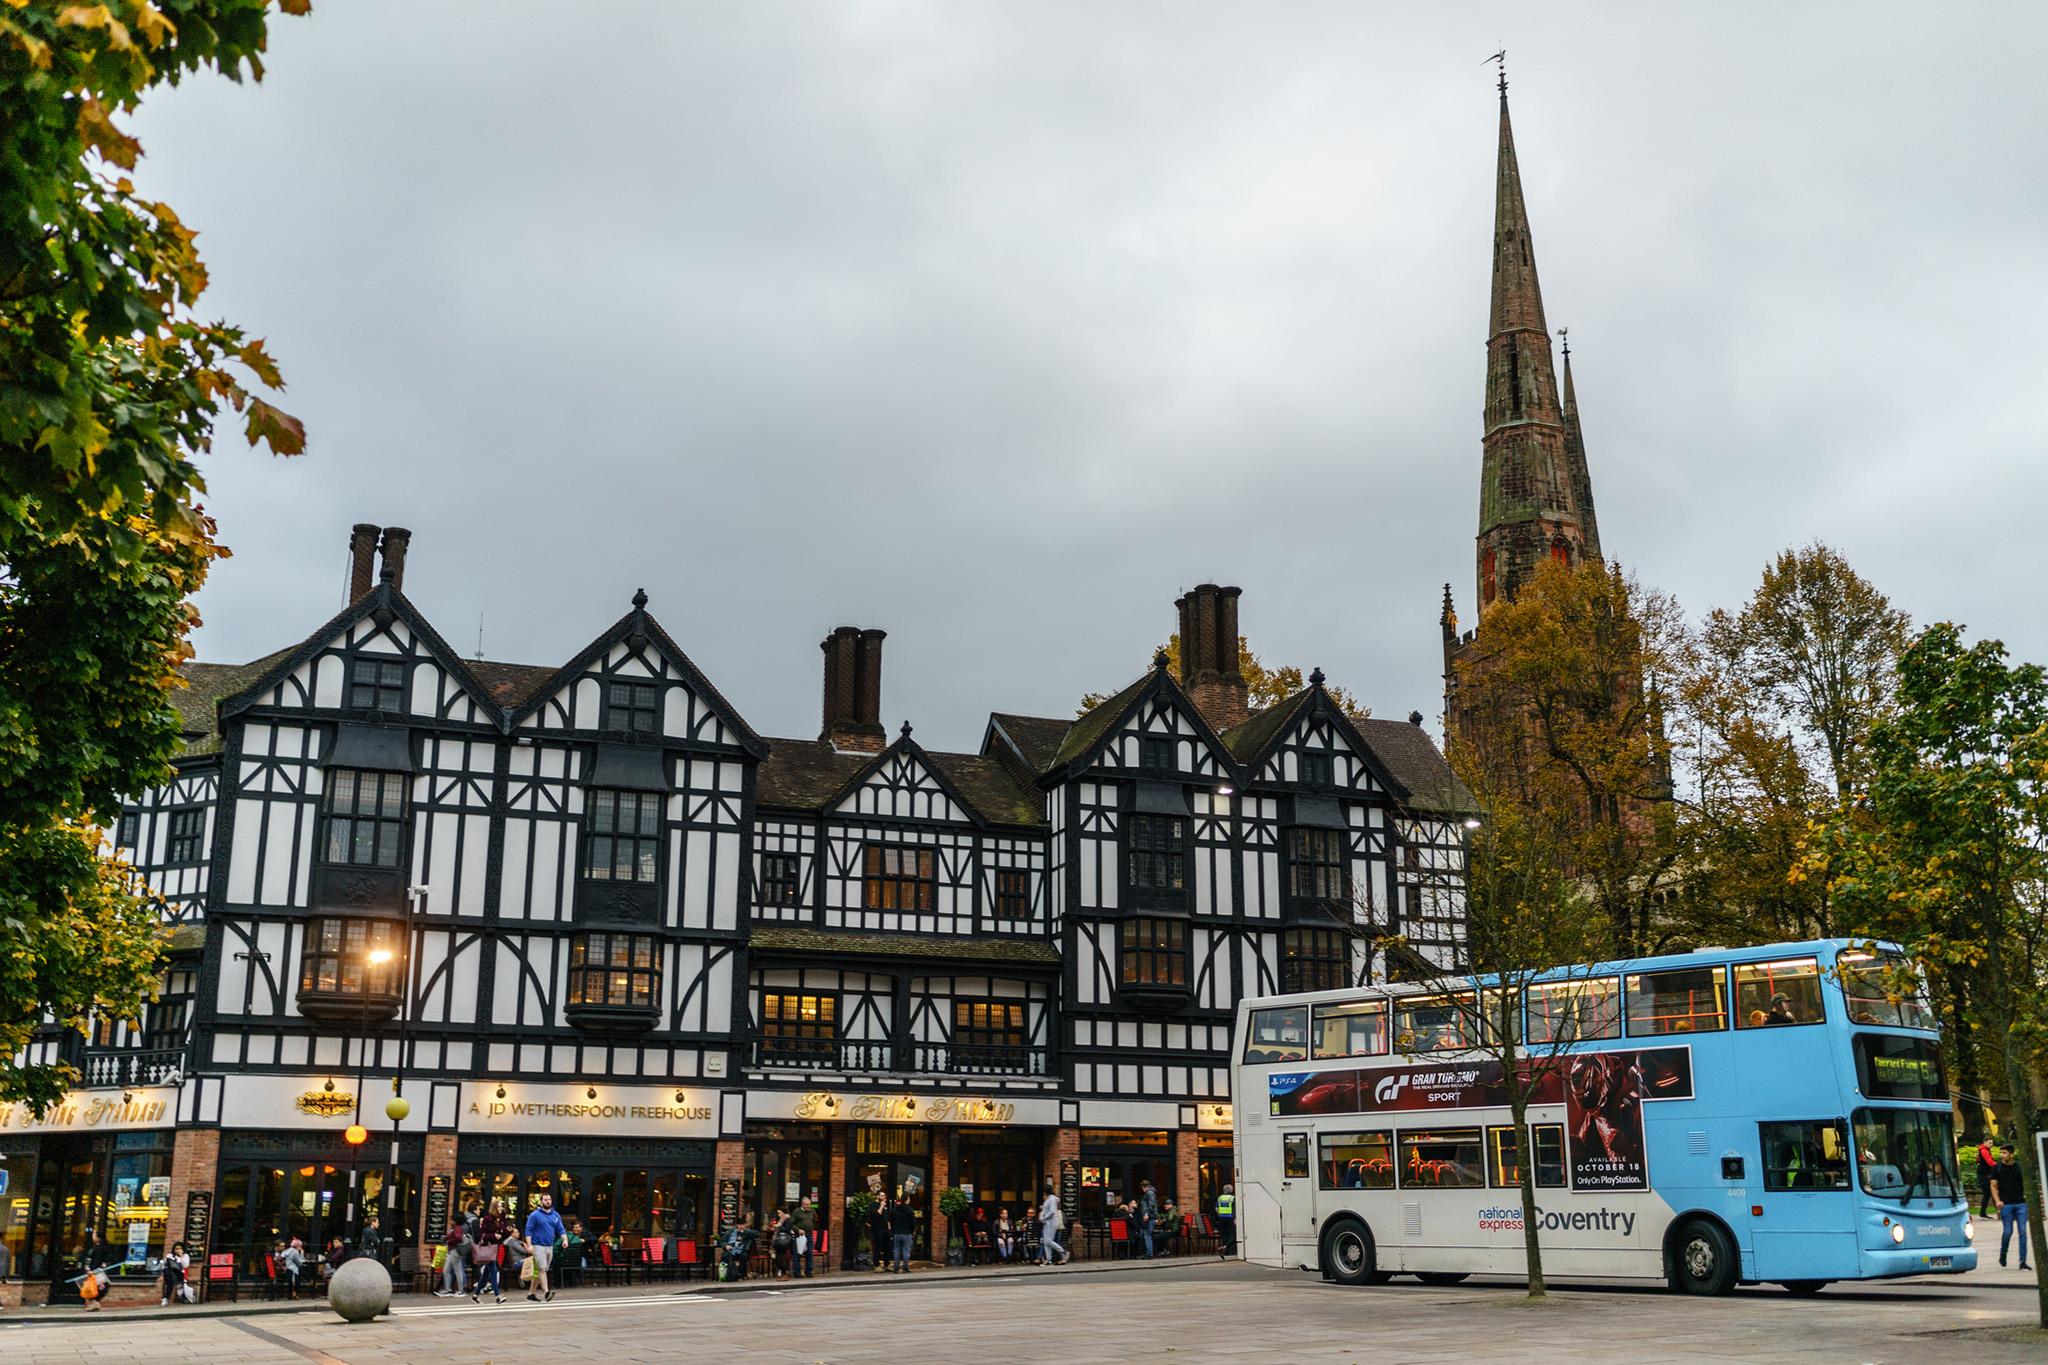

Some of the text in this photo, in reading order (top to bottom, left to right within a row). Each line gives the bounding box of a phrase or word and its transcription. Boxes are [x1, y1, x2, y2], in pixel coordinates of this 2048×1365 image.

[1279, 1077, 1297, 1085] PS4
[1412, 1073, 1436, 1085] GRAN
[1427, 1092, 1461, 1102] SPORT
[84, 1097, 167, 1126] STANDARD
[468, 1102, 712, 1120] A JD WETHERSPOON FREEHOUSE
[1577, 1163, 1640, 1172] OCTOBER 18
[1577, 1176, 1591, 1186] Only
[1591, 1176, 1601, 1185] On
[1478, 1206, 1523, 1219] national
[1479, 1219, 1524, 1232] express
[1534, 1206, 1636, 1237] Coventry
